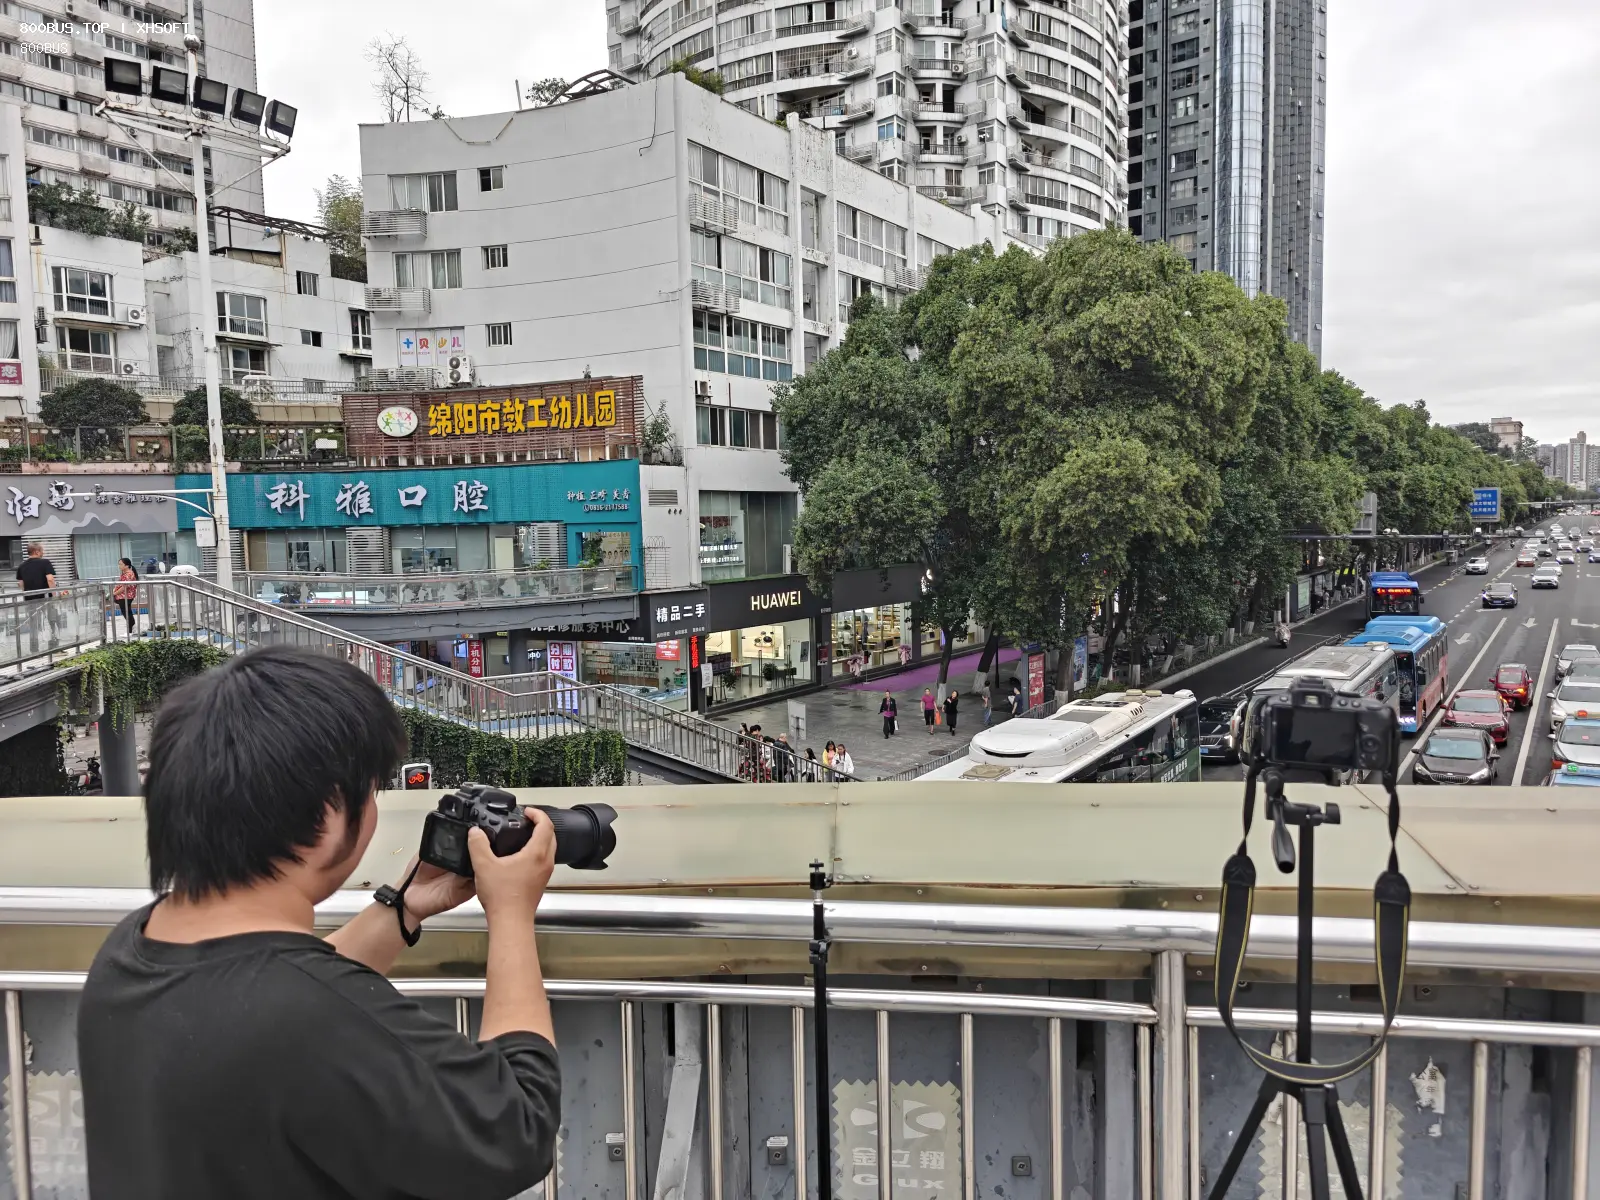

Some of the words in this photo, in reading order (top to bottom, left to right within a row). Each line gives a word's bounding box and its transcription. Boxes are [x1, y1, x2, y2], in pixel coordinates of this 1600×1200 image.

[428, 390, 615, 437] 绵阳市教工幼儿园
[264, 479, 489, 522] 科雅口腔
[656, 603, 706, 623] 精品二手
[751, 590, 801, 611] HUAWEI
[470, 641, 481, 674] 手机分期
[550, 658, 573, 671] 付款
